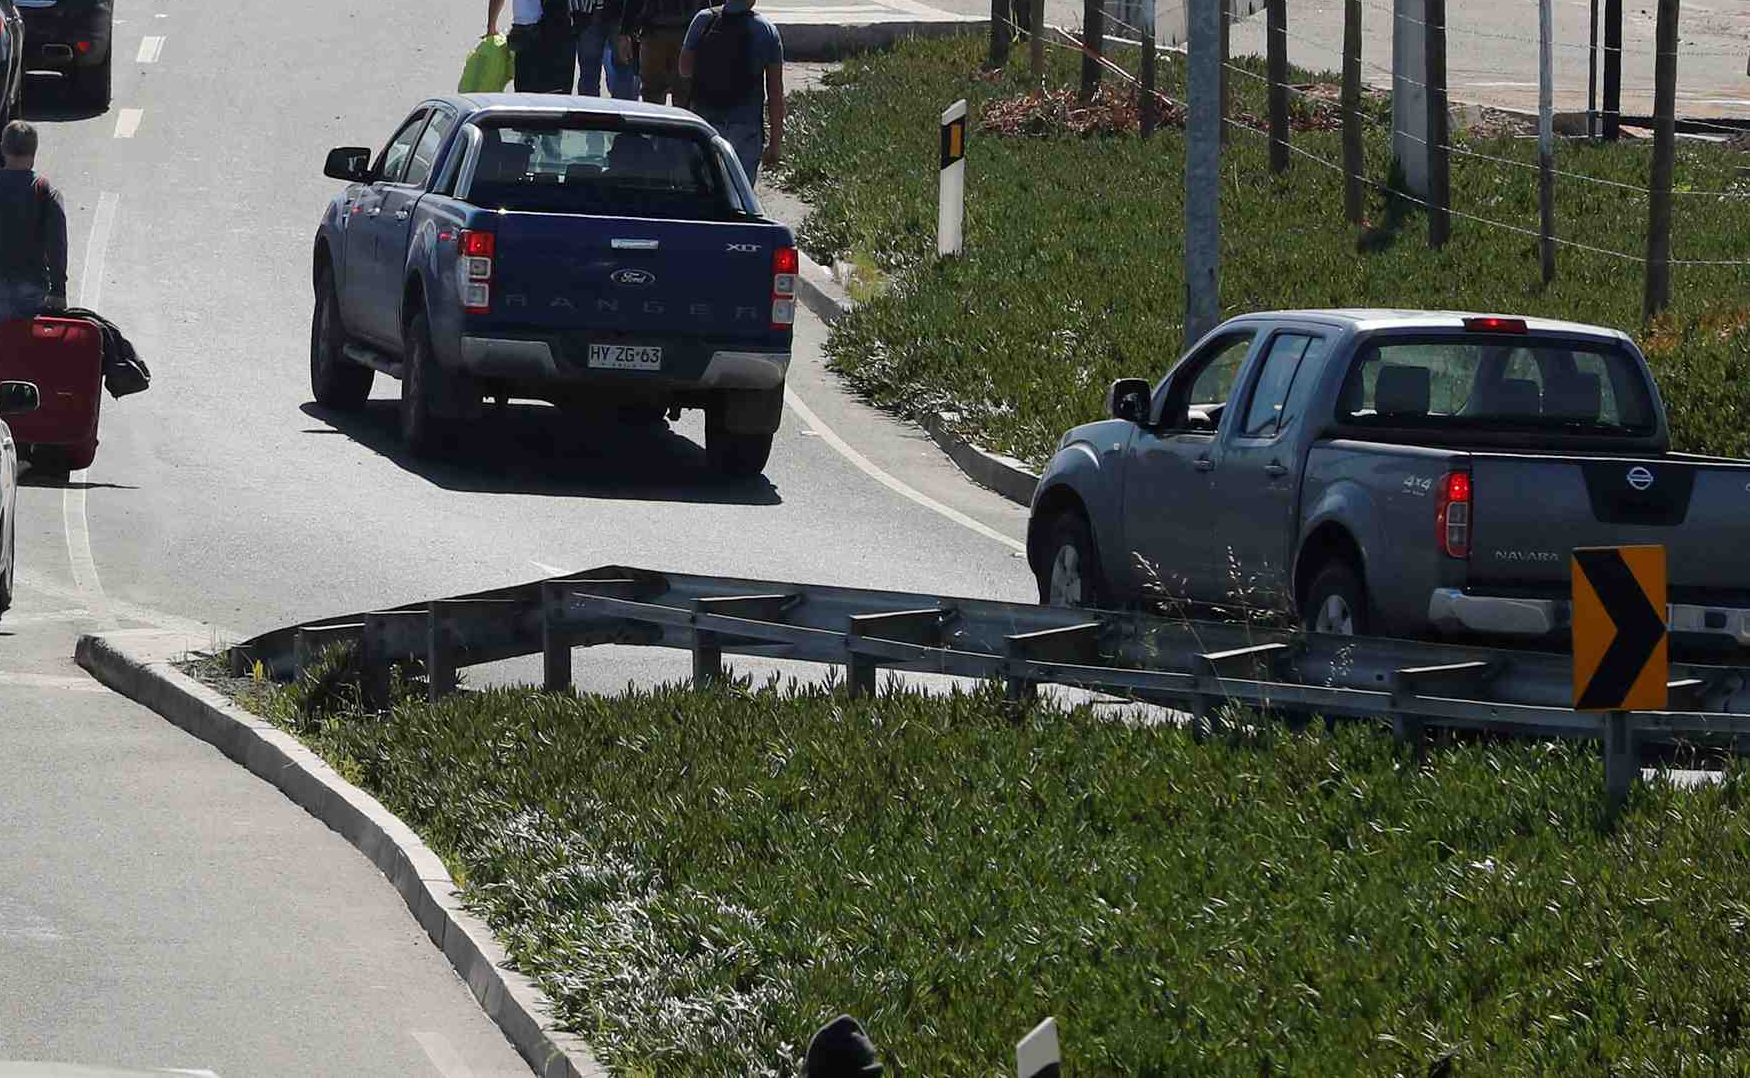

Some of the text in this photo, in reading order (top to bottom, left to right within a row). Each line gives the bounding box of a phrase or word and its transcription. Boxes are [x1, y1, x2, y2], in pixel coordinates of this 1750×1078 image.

[725, 243, 763, 253] XLT
[505, 293, 758, 320] RANGER
[1495, 550, 1560, 562] NAVARA
